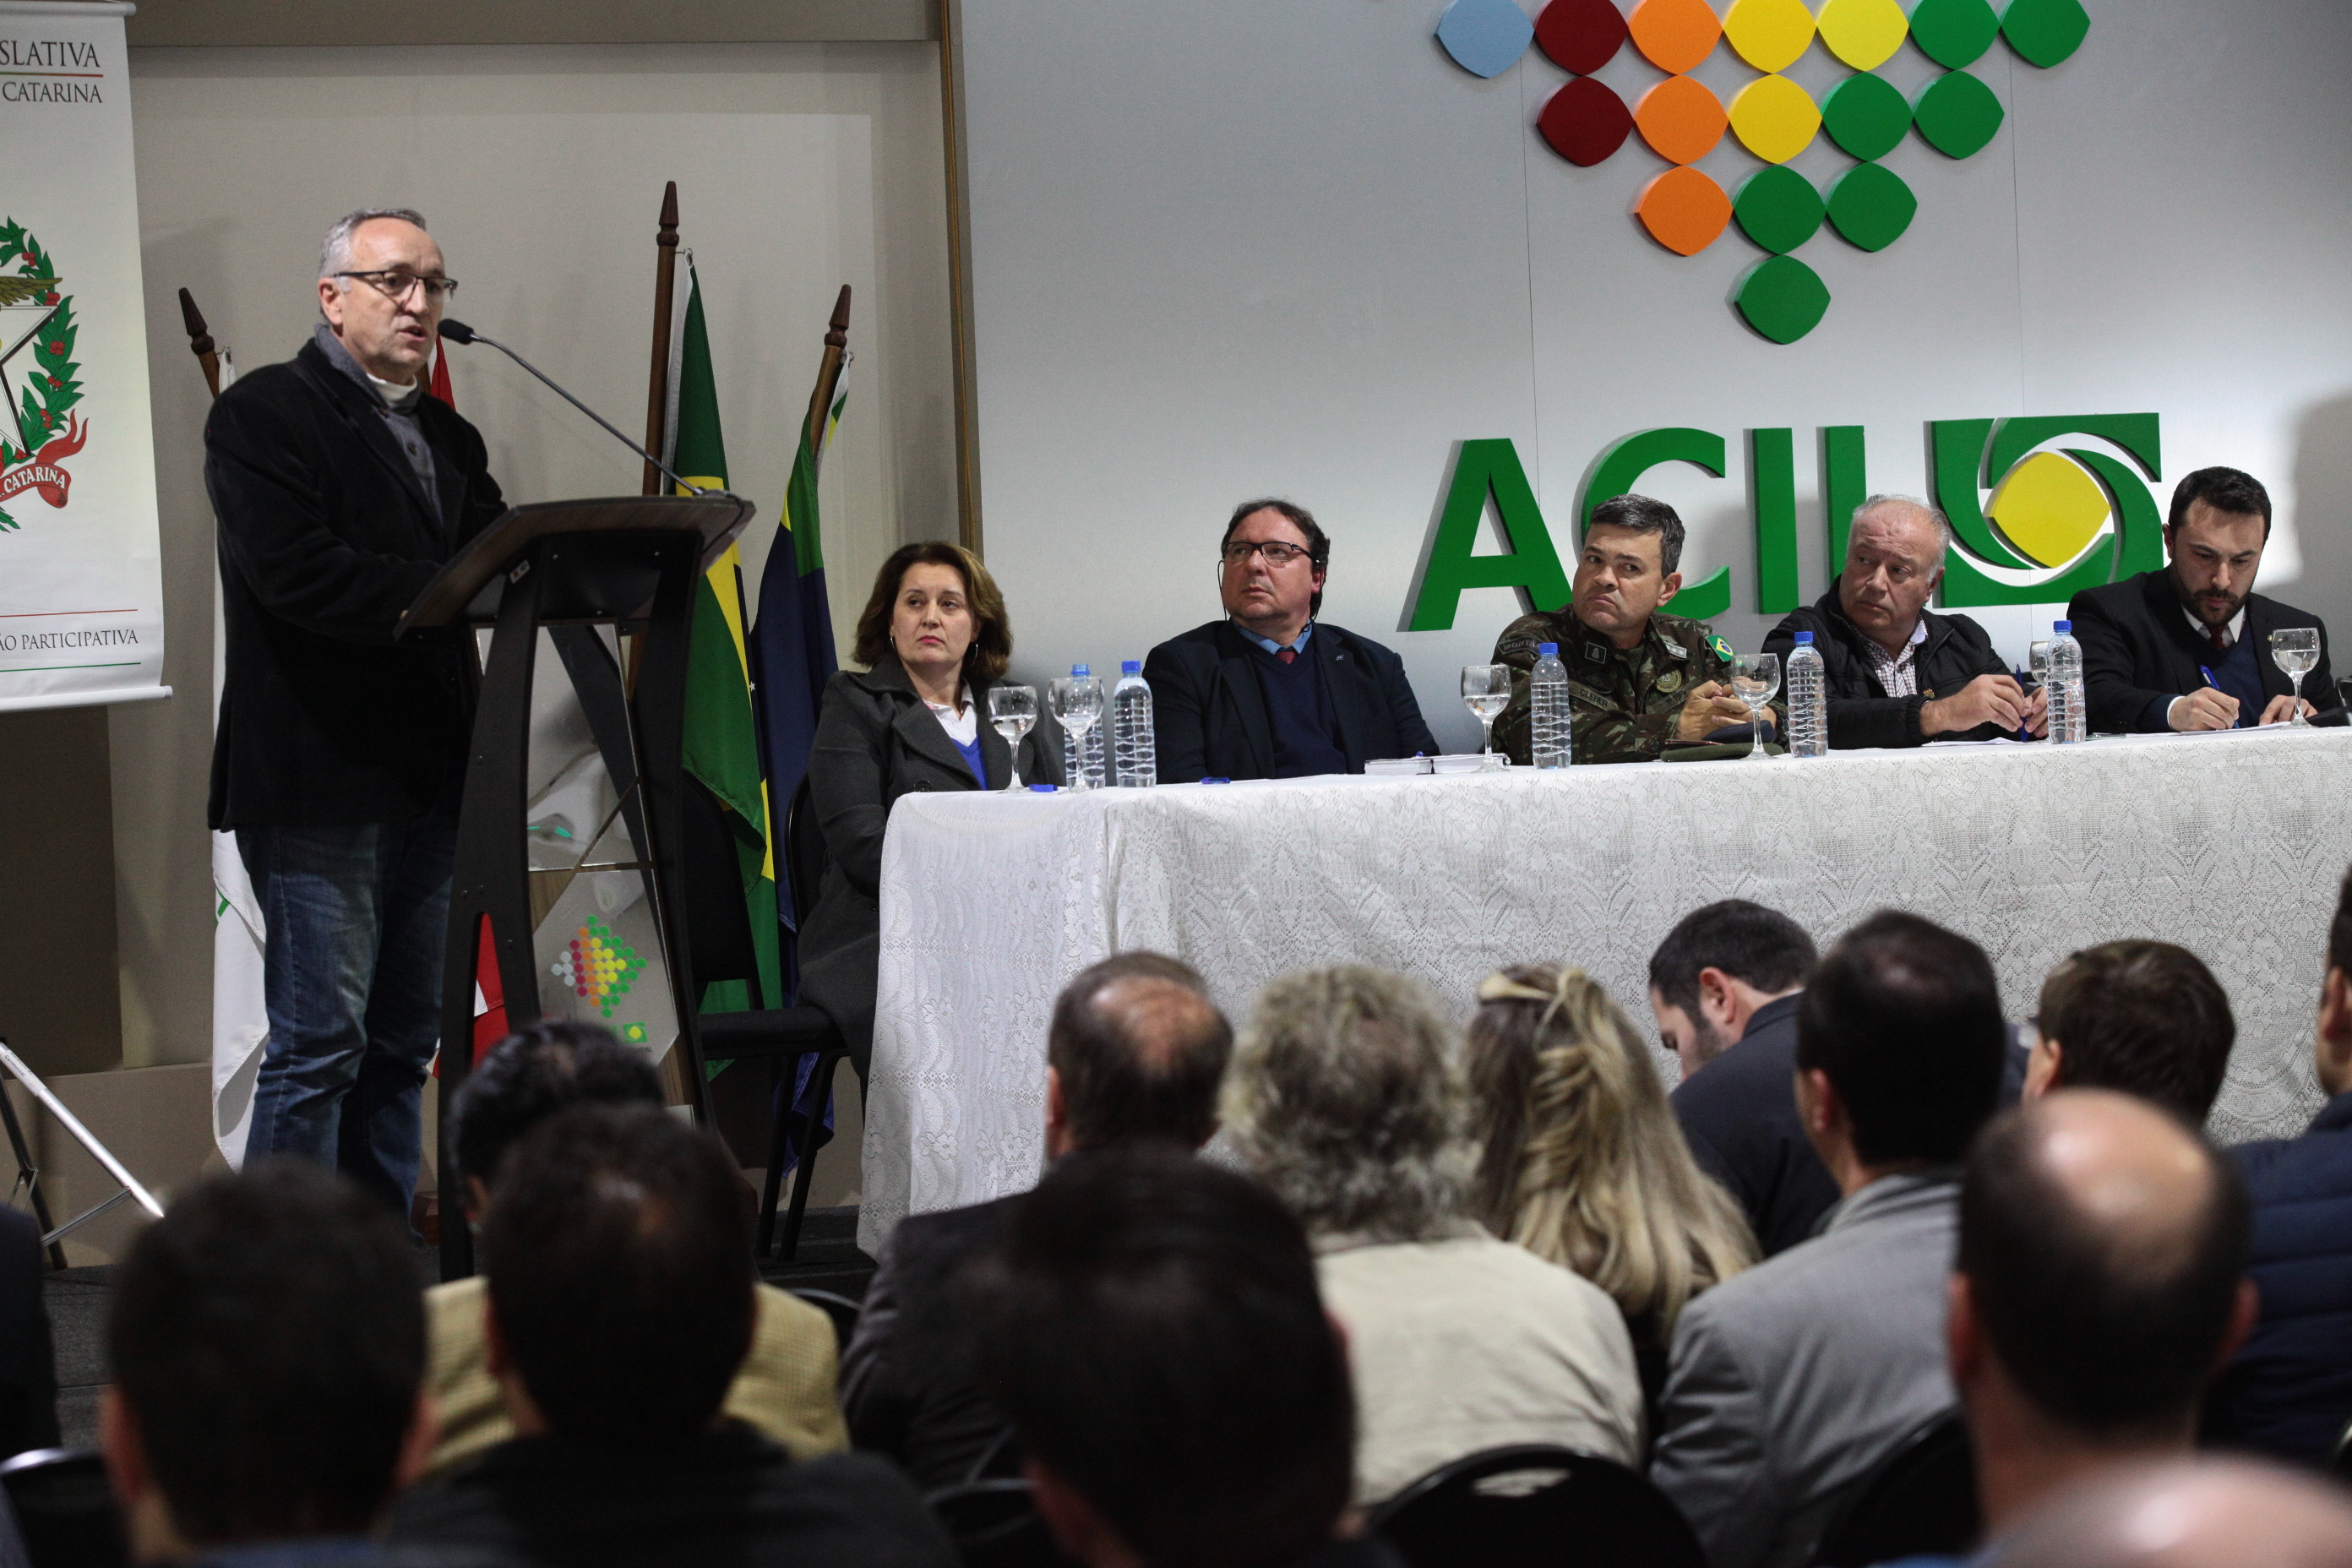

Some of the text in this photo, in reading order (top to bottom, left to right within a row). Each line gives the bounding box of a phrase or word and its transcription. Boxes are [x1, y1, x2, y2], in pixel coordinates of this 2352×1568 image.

[3, 82, 103, 103] CATARINA
[4, 466, 65, 493] CATARINA
[22, 629, 139, 650] PARTICIPATIVA
